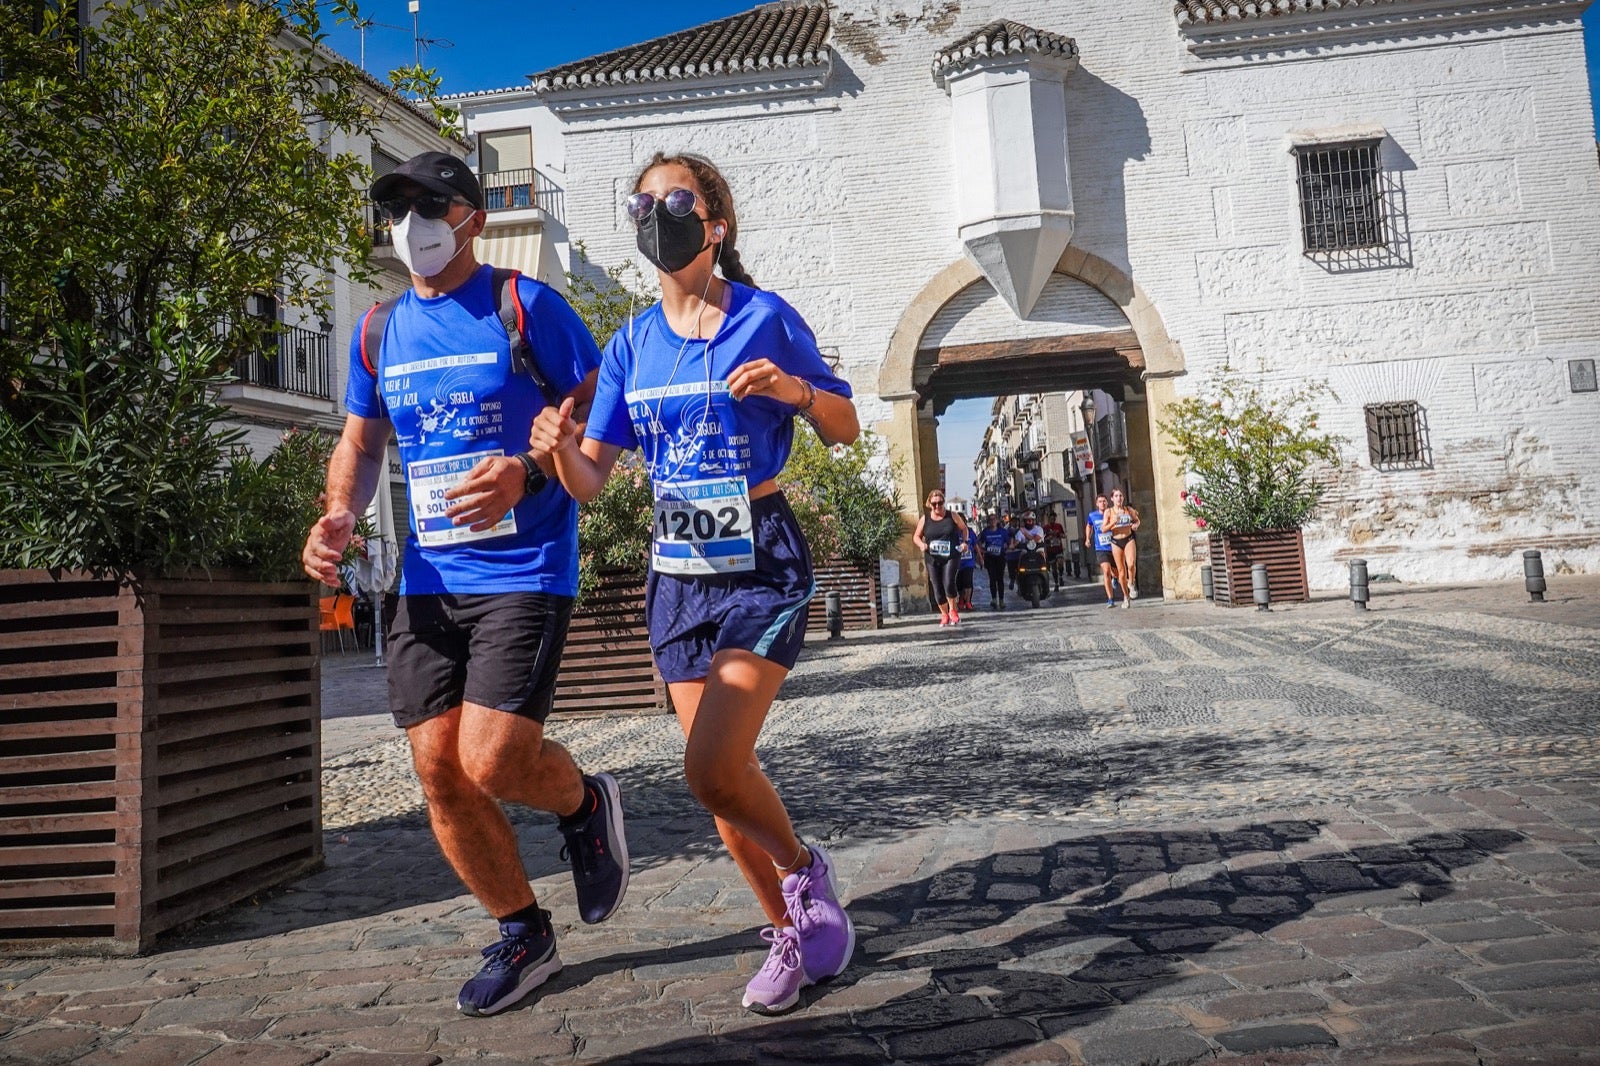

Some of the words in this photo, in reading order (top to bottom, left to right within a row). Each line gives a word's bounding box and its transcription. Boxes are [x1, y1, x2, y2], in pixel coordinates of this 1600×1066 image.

[403, 377, 410, 390] LA
[403, 392, 419, 406] AZUL
[481, 402, 502, 411] DOMINGO
[461, 416, 467, 426] DE
[469, 415, 489, 426] OCTUBRE
[728, 435, 750, 446] DOMINGO
[708, 449, 715, 459] DE
[448, 461, 460, 473] POR
[462, 459, 470, 470] EL
[687, 487, 700, 498] POR
[702, 486, 709, 497] EL
[712, 483, 739, 495] AUTISMO
[659, 506, 742, 541] 1202
